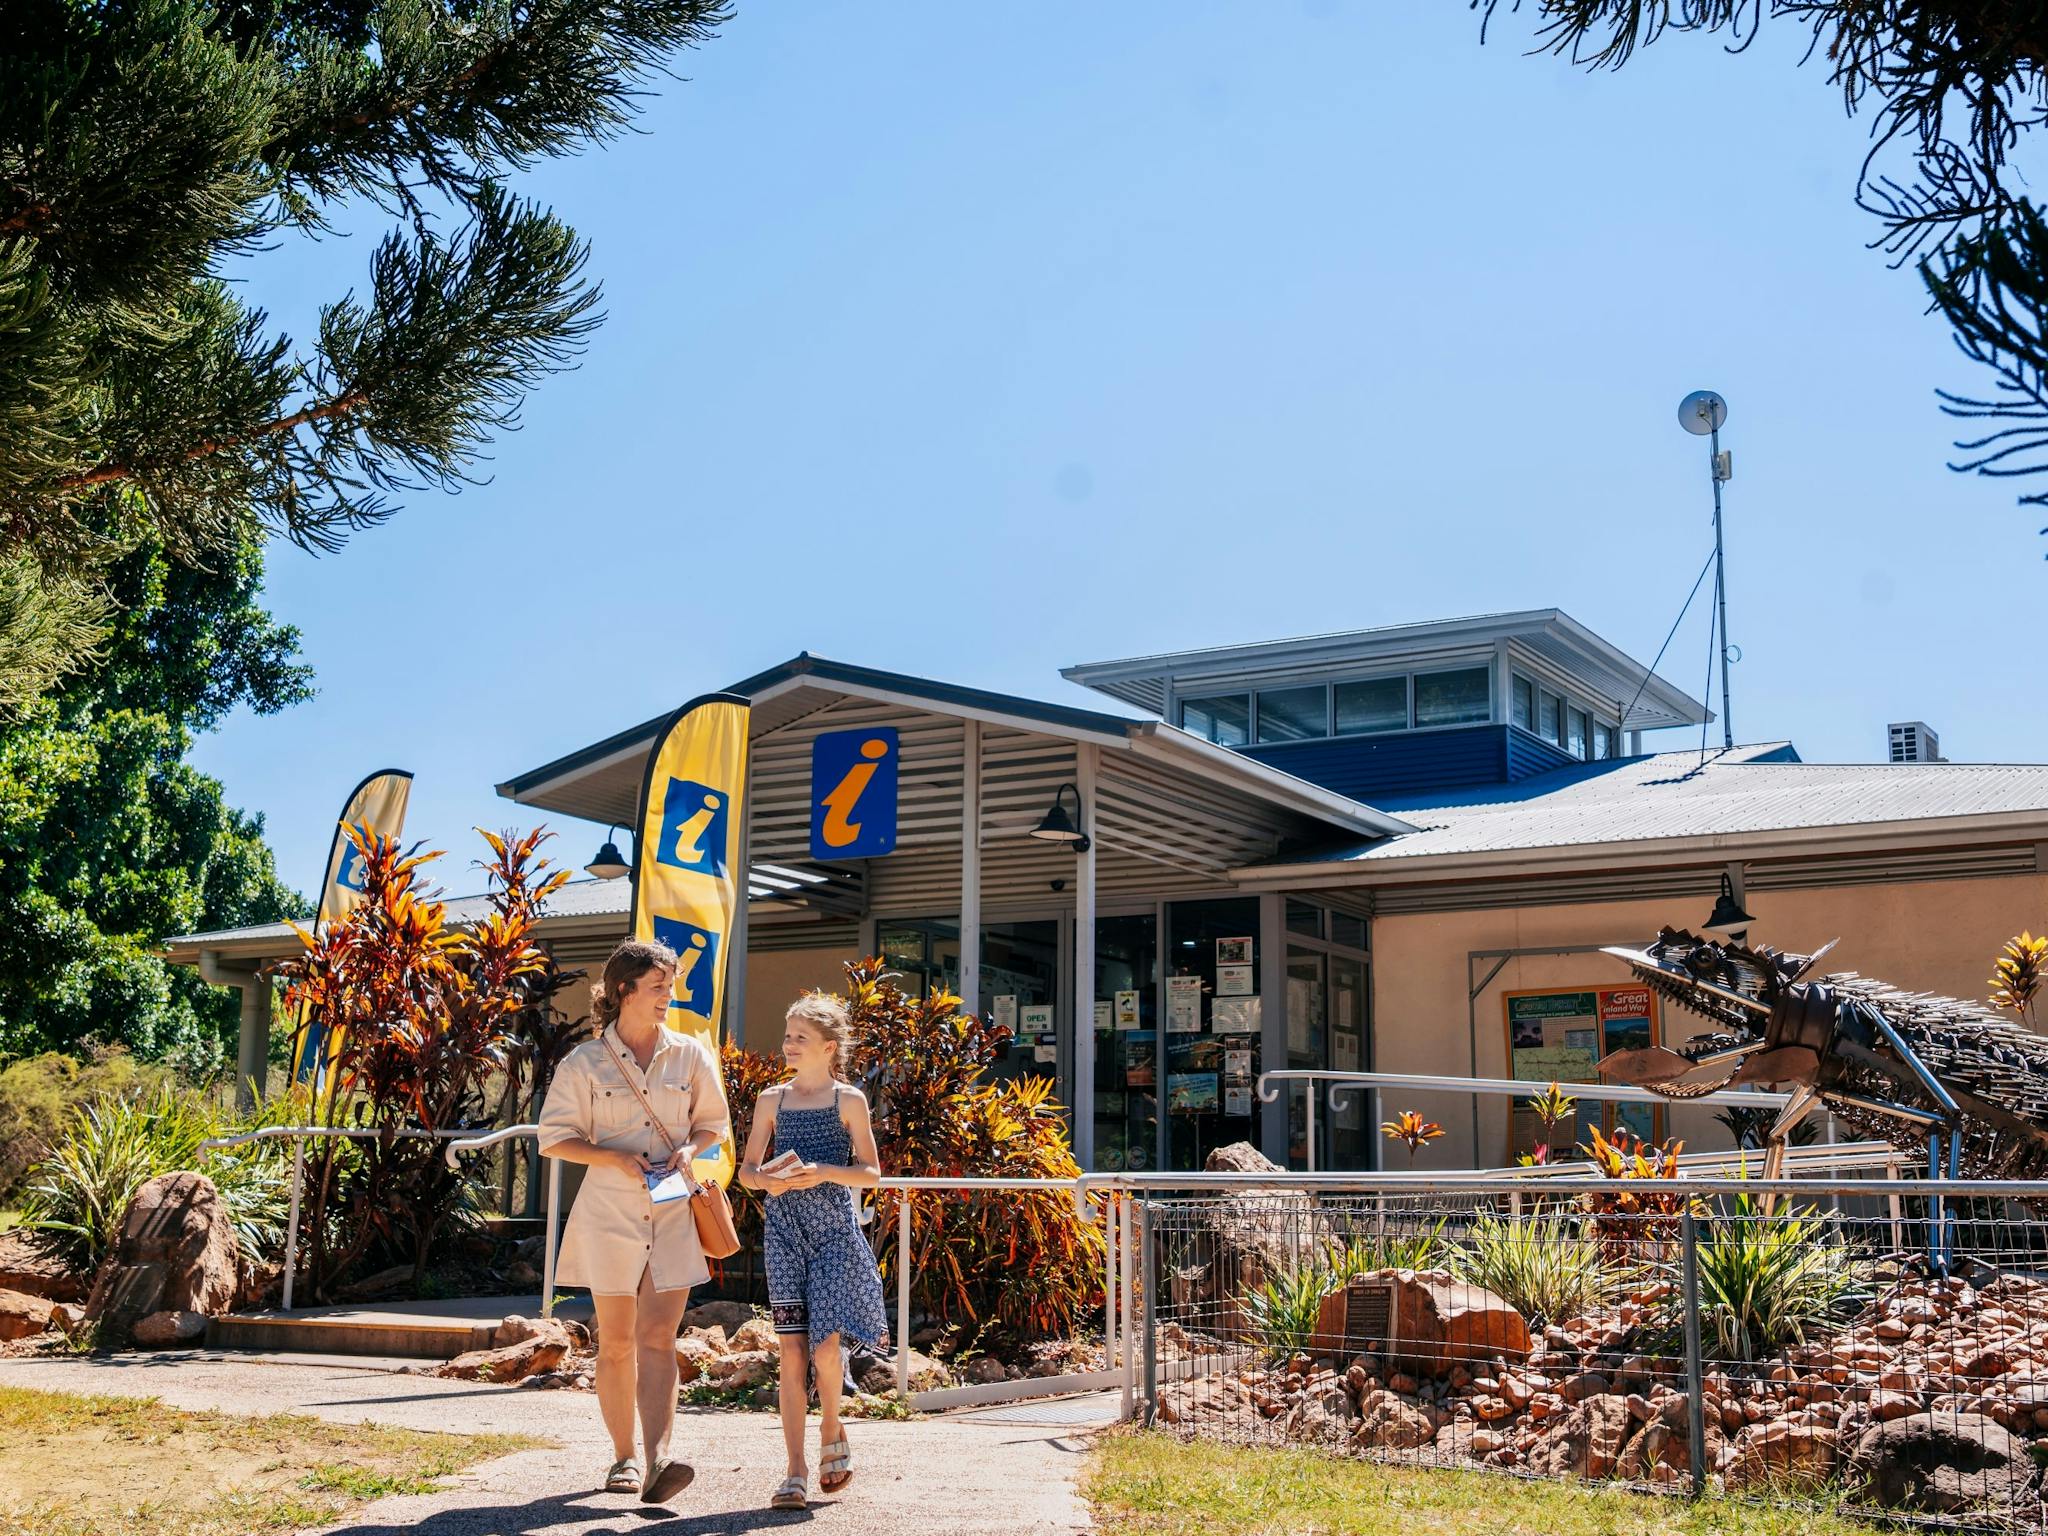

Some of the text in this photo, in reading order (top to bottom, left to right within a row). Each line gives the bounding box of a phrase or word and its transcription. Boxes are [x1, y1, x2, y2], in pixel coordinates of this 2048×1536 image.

[821, 740, 886, 847] i
[676, 795, 719, 864] i
[1613, 992, 1648, 1004] Great
[1629, 1003, 1647, 1013] Way
[1027, 1014, 1047, 1022] OPEN
